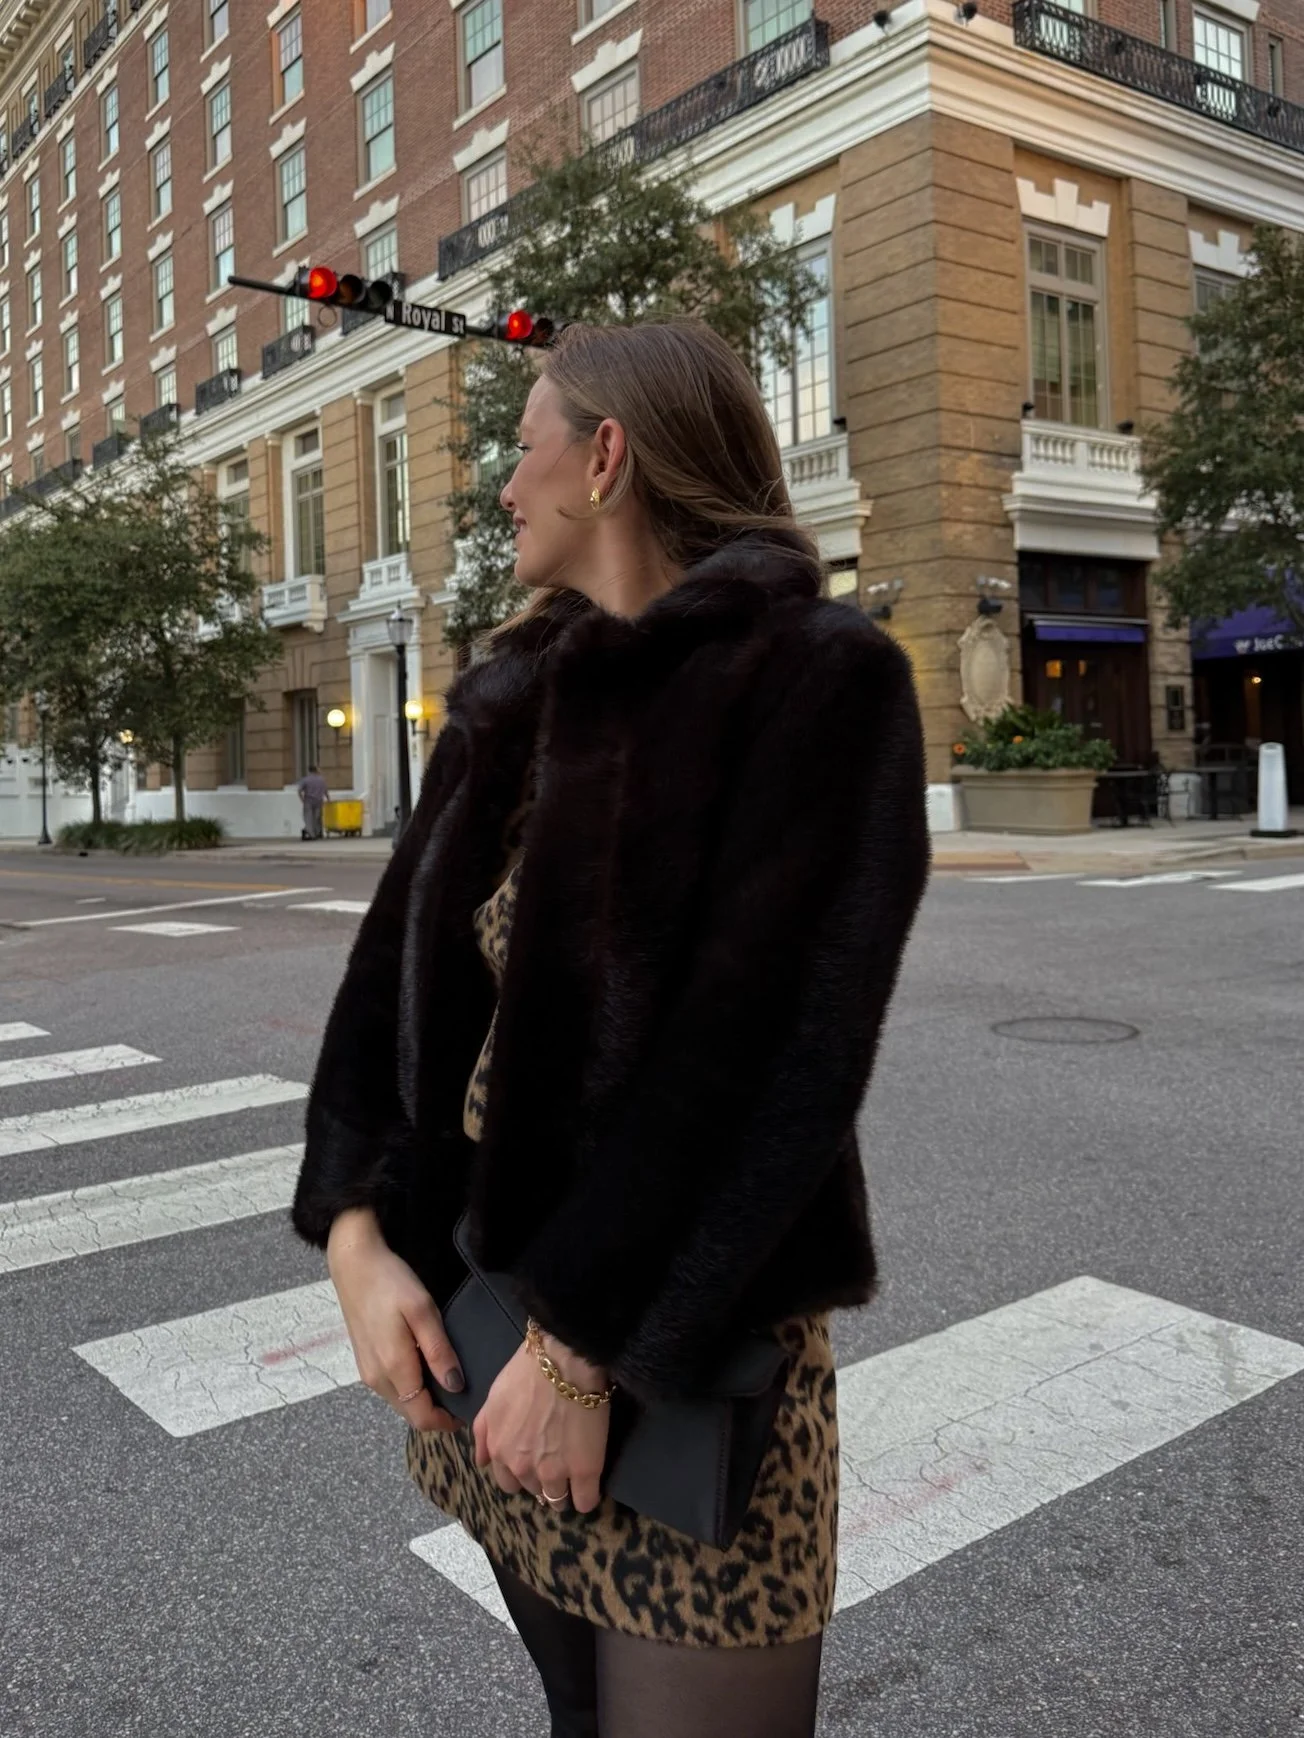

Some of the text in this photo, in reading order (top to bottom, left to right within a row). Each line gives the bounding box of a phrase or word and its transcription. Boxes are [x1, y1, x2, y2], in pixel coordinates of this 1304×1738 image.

[386, 301, 464, 334] N Royal St
